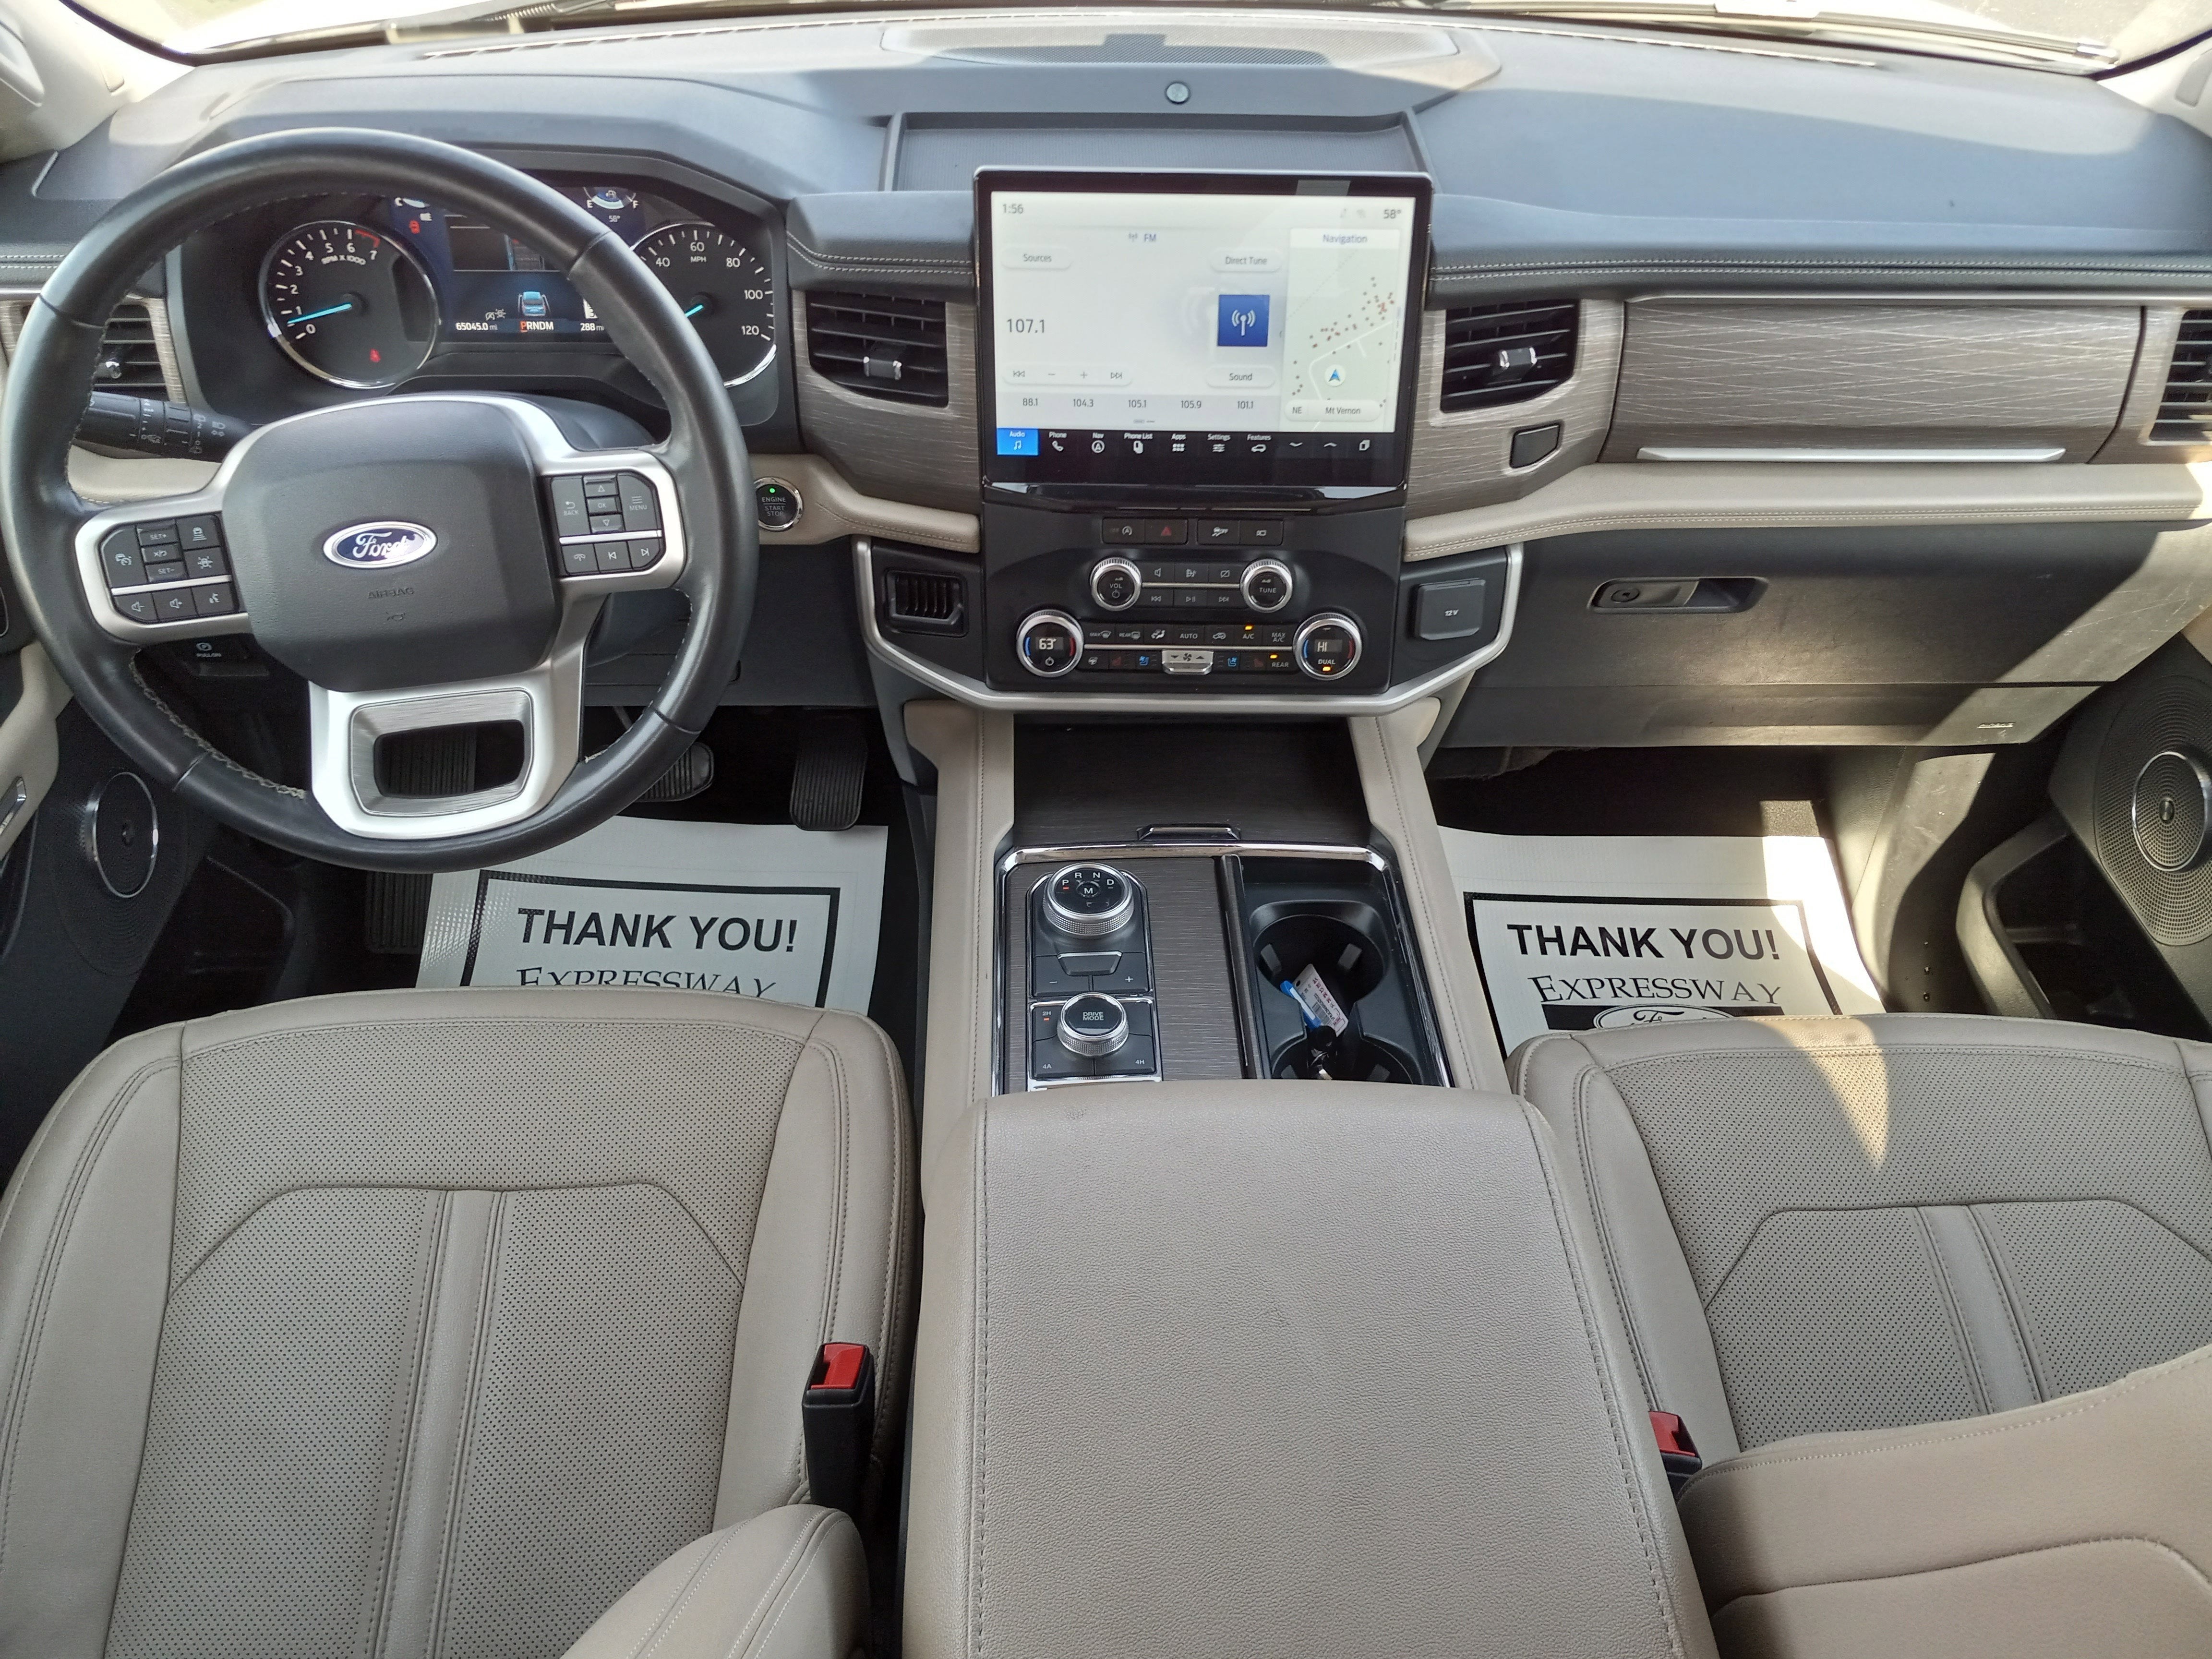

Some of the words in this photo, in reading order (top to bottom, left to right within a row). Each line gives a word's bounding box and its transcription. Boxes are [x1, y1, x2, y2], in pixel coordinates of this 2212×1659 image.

[587, 199, 593, 208] E
[632, 200, 639, 209] F
[1002, 204, 1024, 215] 1:56
[1383, 209, 1402, 219] 58°
[1143, 233, 1157, 242] FM
[1322, 234, 1368, 244] Navigation
[326, 243, 334, 253] 5
[347, 243, 355, 253] 6
[690, 242, 705, 252] 60
[305, 251, 314, 260] 4
[347, 255, 366, 265] 1000
[370, 250, 378, 260] 7
[1023, 253, 1052, 263] Sources
[655, 257, 670, 267] 40
[726, 257, 740, 267] 80
[1225, 256, 1247, 265] Direct
[1249, 256, 1267, 265] Tune
[296, 266, 303, 276] 3
[289, 285, 299, 294] 2
[744, 289, 763, 300] 100
[295, 306, 302, 315] 1
[306, 324, 316, 334] 0
[456, 322, 489, 331] 65045.0
[580, 323, 596, 331] 288
[741, 325, 759, 335] 120
[1006, 319, 1046, 334] 107.1
[1229, 373, 1252, 381] Sound
[1022, 398, 1039, 407] 88.1
[1072, 398, 1094, 408] 104.3
[1128, 399, 1147, 408] 105.1
[1180, 400, 1202, 409] 105.9
[1237, 401, 1254, 409] 101.1
[1292, 407, 1302, 415] NE
[1325, 407, 1334, 415] Mt
[1336, 407, 1361, 415] Vernon
[352, 531, 409, 558] Ford
[1039, 638, 1057, 650] 63°
[1317, 641, 1327, 652] HI
[517, 908, 677, 949] THANK
[689, 915, 797, 952] YOU!
[1506, 924, 1666, 959] THANK
[1669, 928, 1780, 960] YOU!
